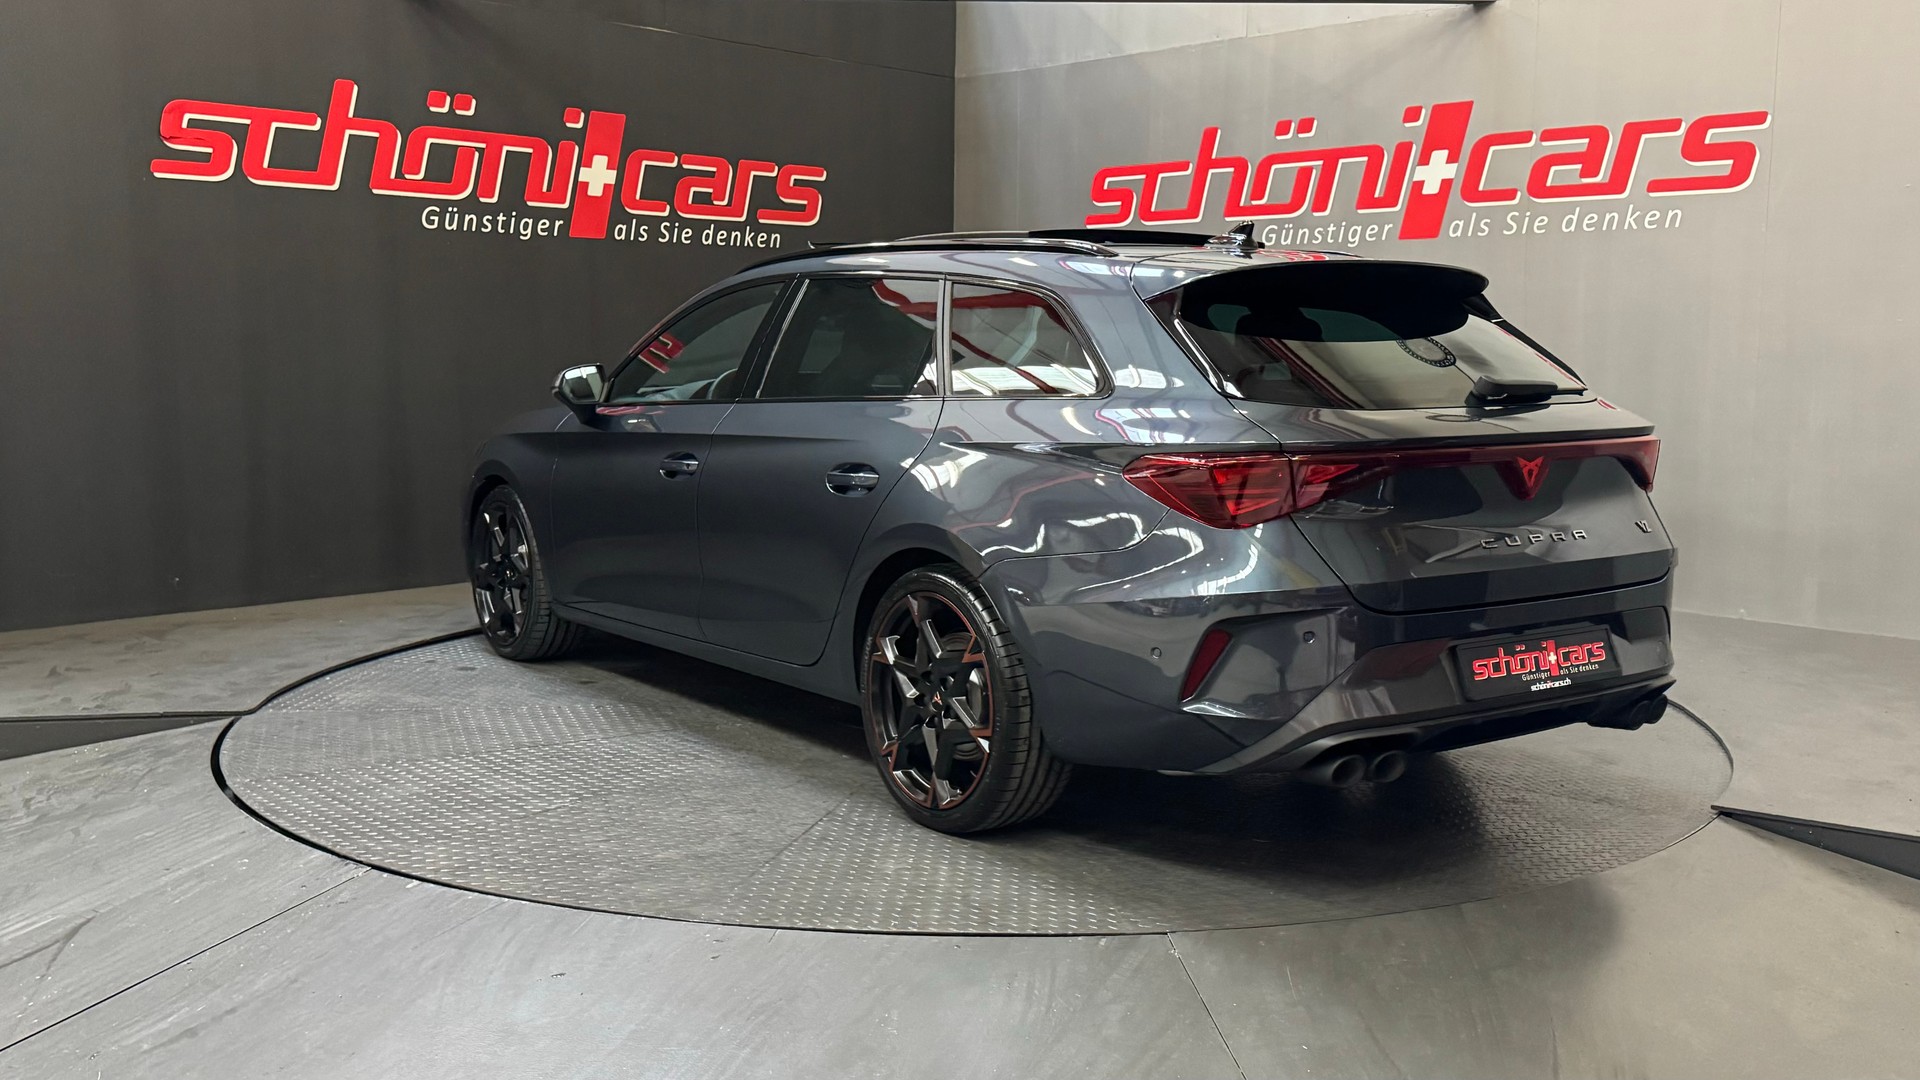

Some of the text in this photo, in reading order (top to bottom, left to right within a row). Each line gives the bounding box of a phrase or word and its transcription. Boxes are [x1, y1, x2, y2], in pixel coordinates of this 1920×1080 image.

[421, 205, 782, 249] Günstiger als Sie denken
[1261, 205, 1683, 248] Günstiger als Sie denken
[1480, 529, 1588, 549] CUPRA
[1521, 663, 1599, 682] Günstiger als Sie denken
